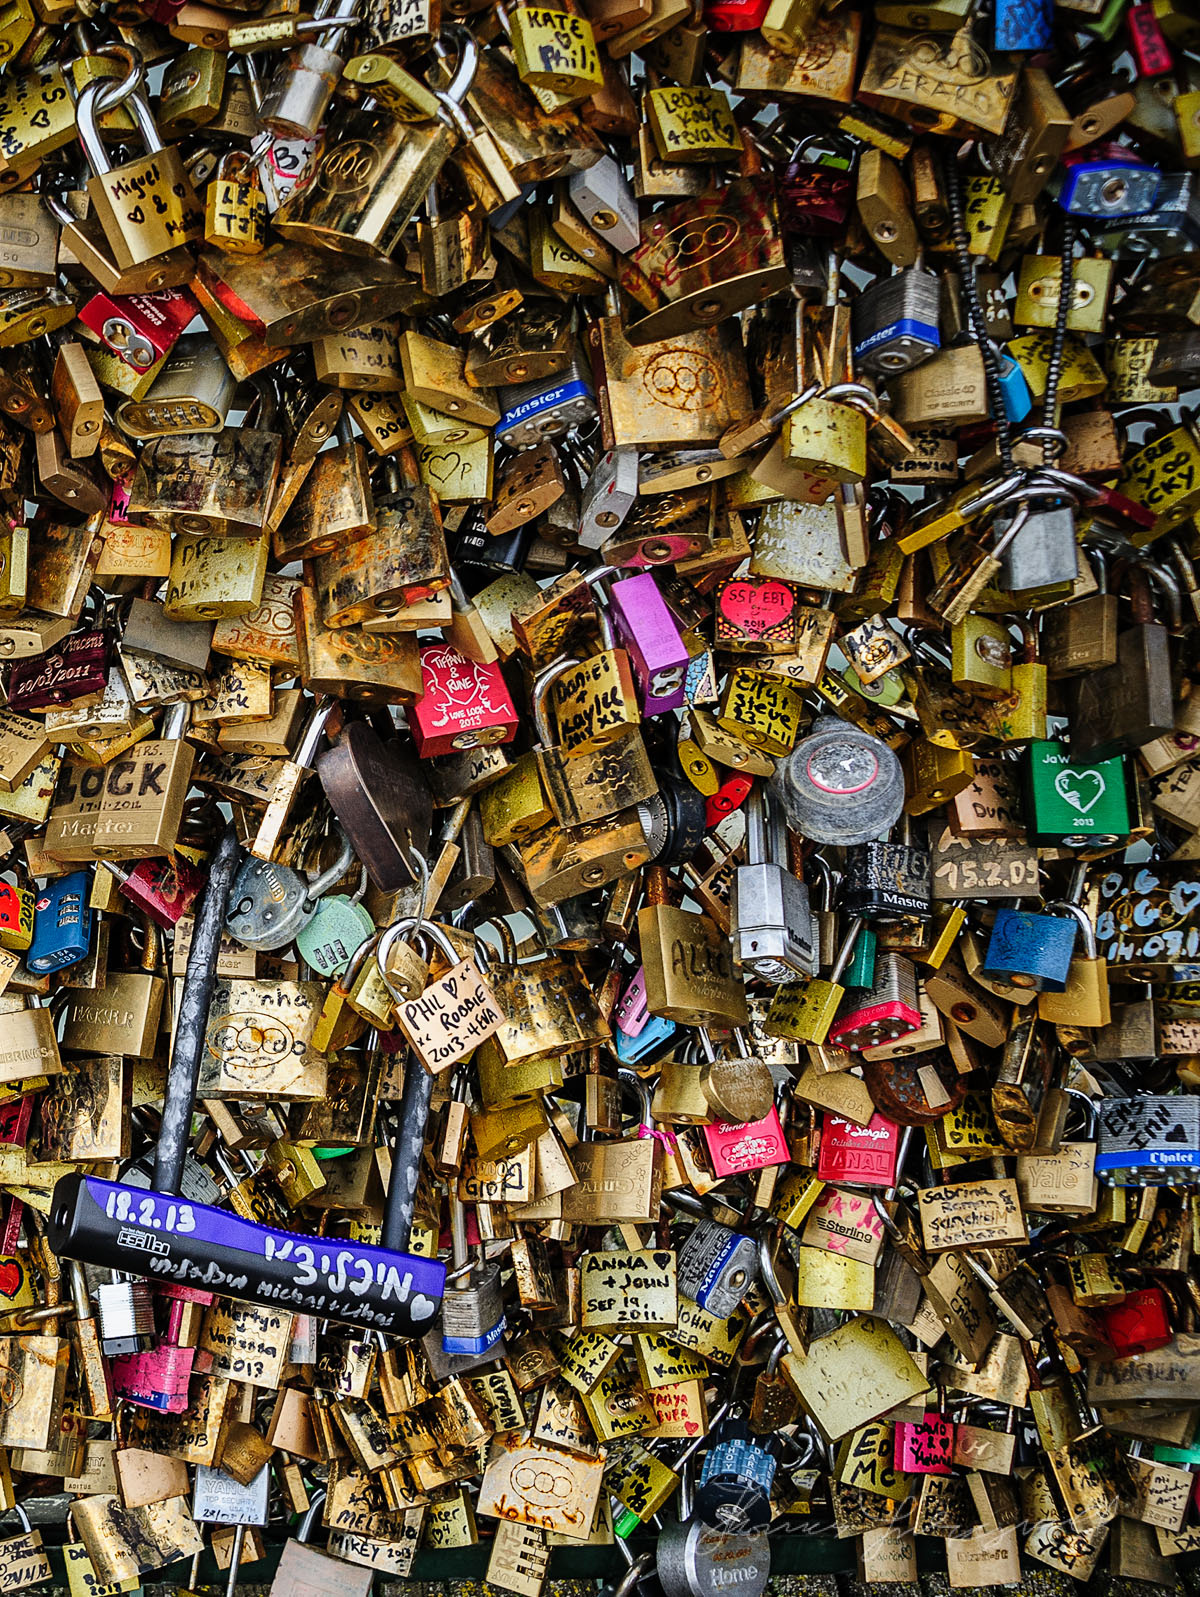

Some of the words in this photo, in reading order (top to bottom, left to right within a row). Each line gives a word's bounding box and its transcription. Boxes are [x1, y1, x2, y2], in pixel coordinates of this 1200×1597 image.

[391, 14, 426, 36] 2013
[527, 10, 584, 39] KATE
[110, 163, 160, 201] Miguel
[505, 387, 564, 424] Master
[729, 588, 756, 604] SSP
[743, 619, 766, 629] 2013
[18, 664, 90, 694] 20/01/2011
[450, 667, 459, 678] &
[445, 675, 474, 694] RUNE
[449, 710, 467, 721] LOVE
[467, 706, 485, 717] LOCK
[458, 716, 482, 729] 2013
[55, 760, 165, 808] LOCK
[59, 820, 141, 837] Master
[1072, 817, 1095, 827] 2013
[882, 892, 929, 911] Master
[51, 950, 70, 960] TSA
[404, 998, 447, 1032] PHIL
[439, 983, 486, 1030] ROBBIE
[852, 1126, 890, 1140] Sergio
[1149, 1151, 1194, 1164] Chalet
[1028, 1166, 1078, 1190] Yale
[105, 1190, 197, 1233] 18.2.13
[825, 1219, 873, 1243] Sterling
[586, 1255, 646, 1271] ANNA
[586, 1298, 616, 1314] SEP
[610, 1413, 652, 1432] Maggie
[178, 1431, 210, 1448] 2013
[330, 1533, 380, 1560] MIKEY
[710, 1565, 759, 1586] Home
